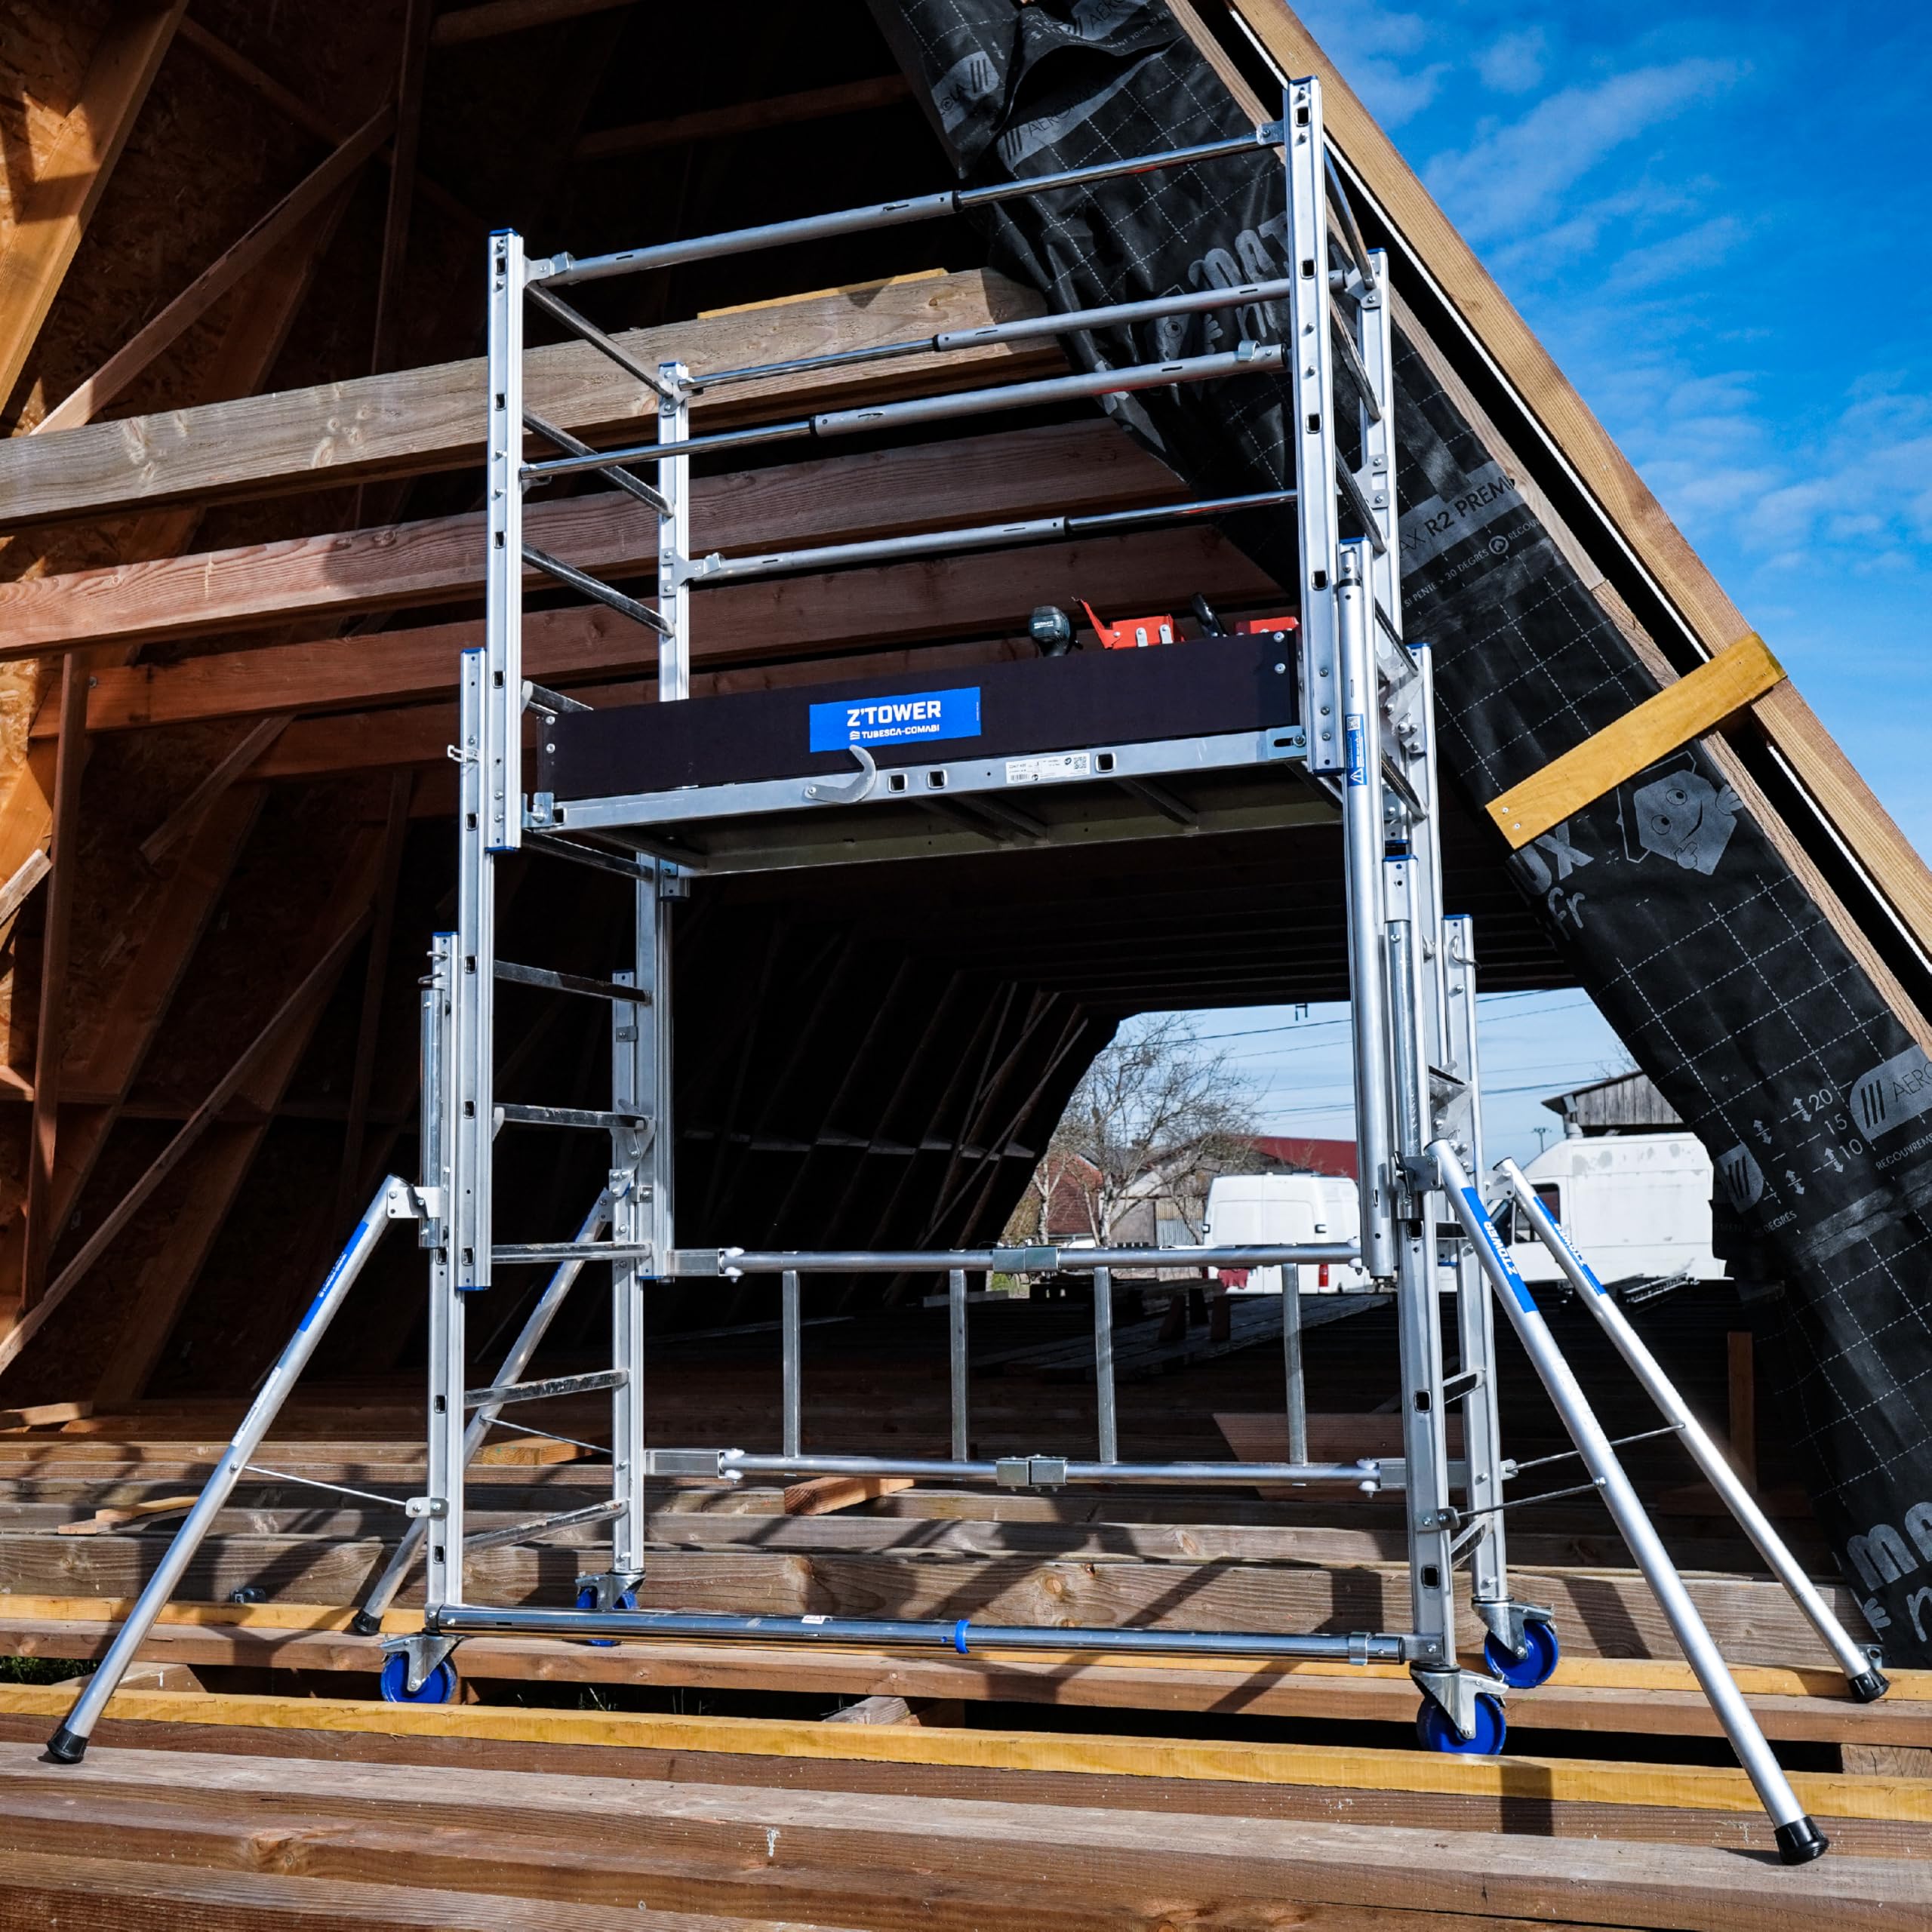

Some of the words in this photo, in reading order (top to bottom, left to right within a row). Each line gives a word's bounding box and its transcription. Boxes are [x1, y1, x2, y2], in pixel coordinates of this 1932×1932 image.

[1424, 511, 1455, 537] R2
[1445, 568, 1458, 581] 30
[847, 700, 942, 727] Z'TOWER
[862, 724, 940, 740] TUBESCA-COMABI
[1808, 1088, 1834, 1112] 20
[1824, 1113, 1847, 1135] 15
[1839, 1138, 1863, 1160] 10
